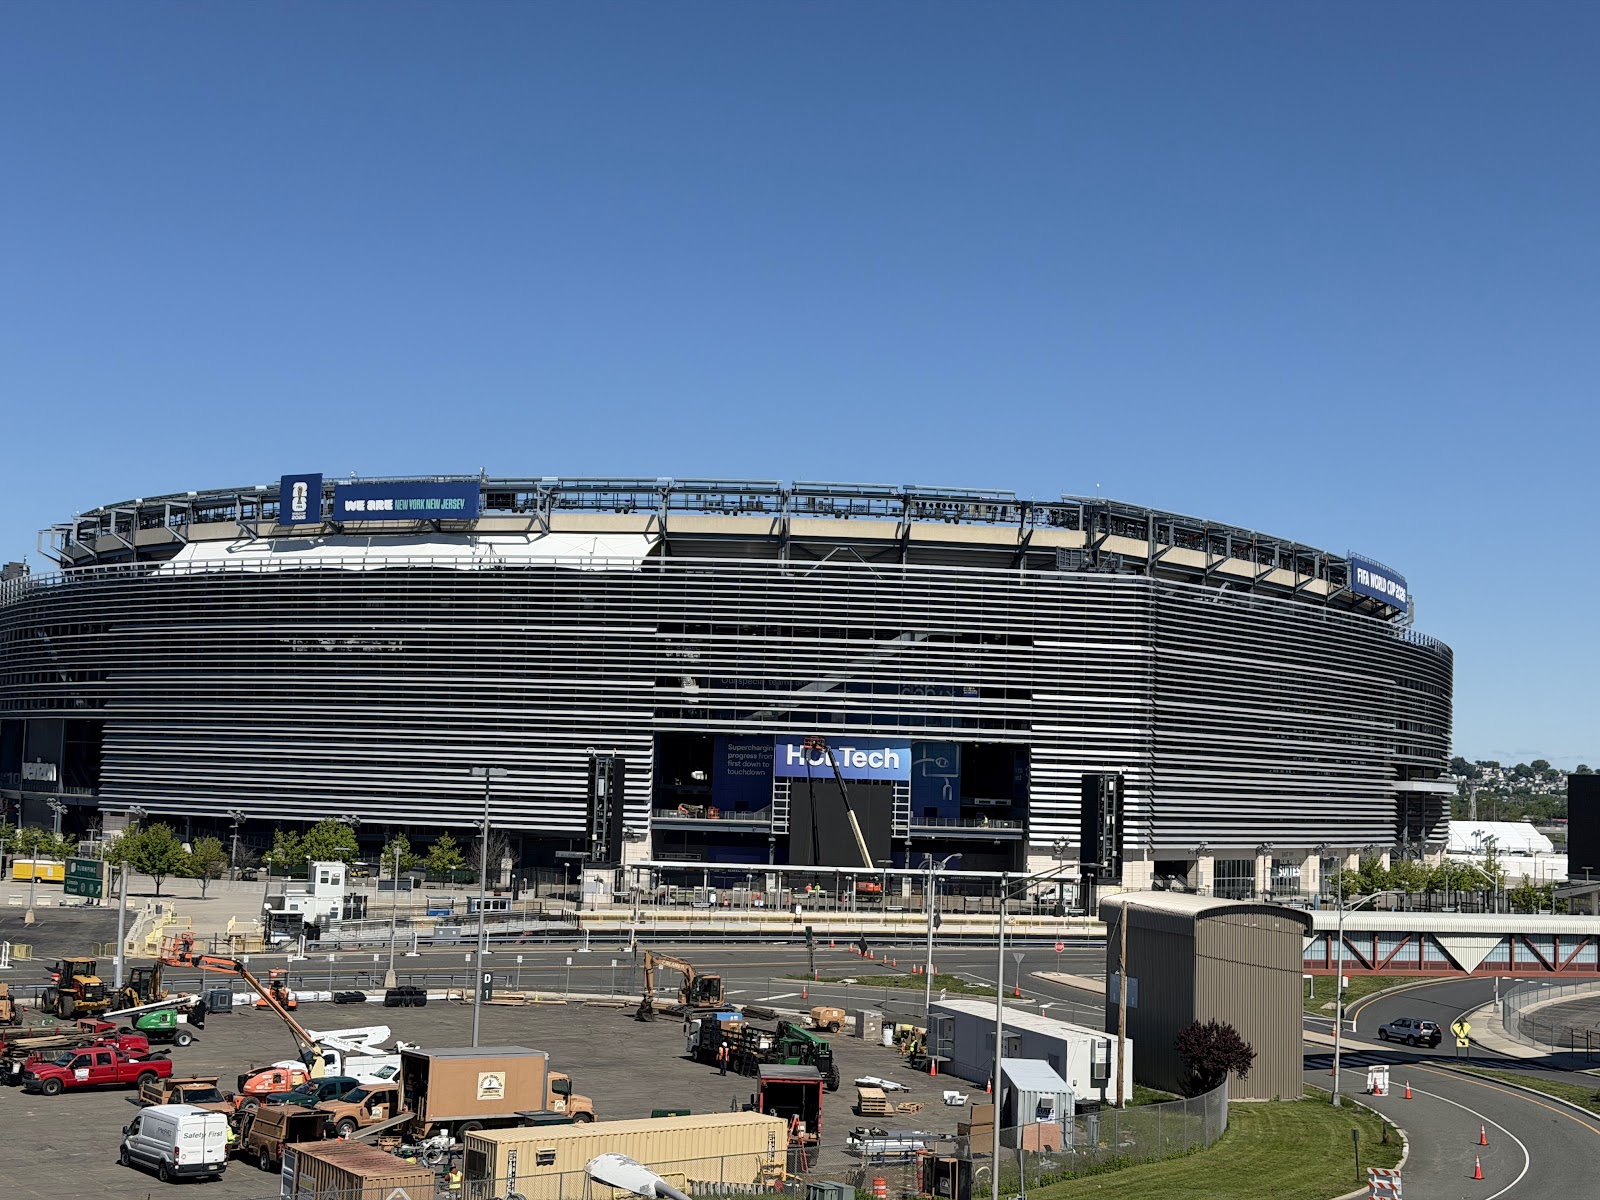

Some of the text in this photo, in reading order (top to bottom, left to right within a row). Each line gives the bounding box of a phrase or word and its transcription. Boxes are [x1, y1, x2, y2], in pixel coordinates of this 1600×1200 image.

[345, 500, 365, 511] WE
[395, 500, 408, 510] NEW
[409, 499, 425, 510] YORK
[426, 499, 441, 510] NEW
[441, 498, 465, 510] JERSEY
[1357, 568, 1370, 587] FIFA
[1370, 572, 1387, 593] WORLD
[1387, 580, 1396, 596] CUP
[728, 743, 774, 752] Superchargin
[1279, 866, 1300, 876] SUITES
[661, 960, 685, 969] CREAMER
[484, 974, 491, 984] D
[485, 990, 489, 999] 1
